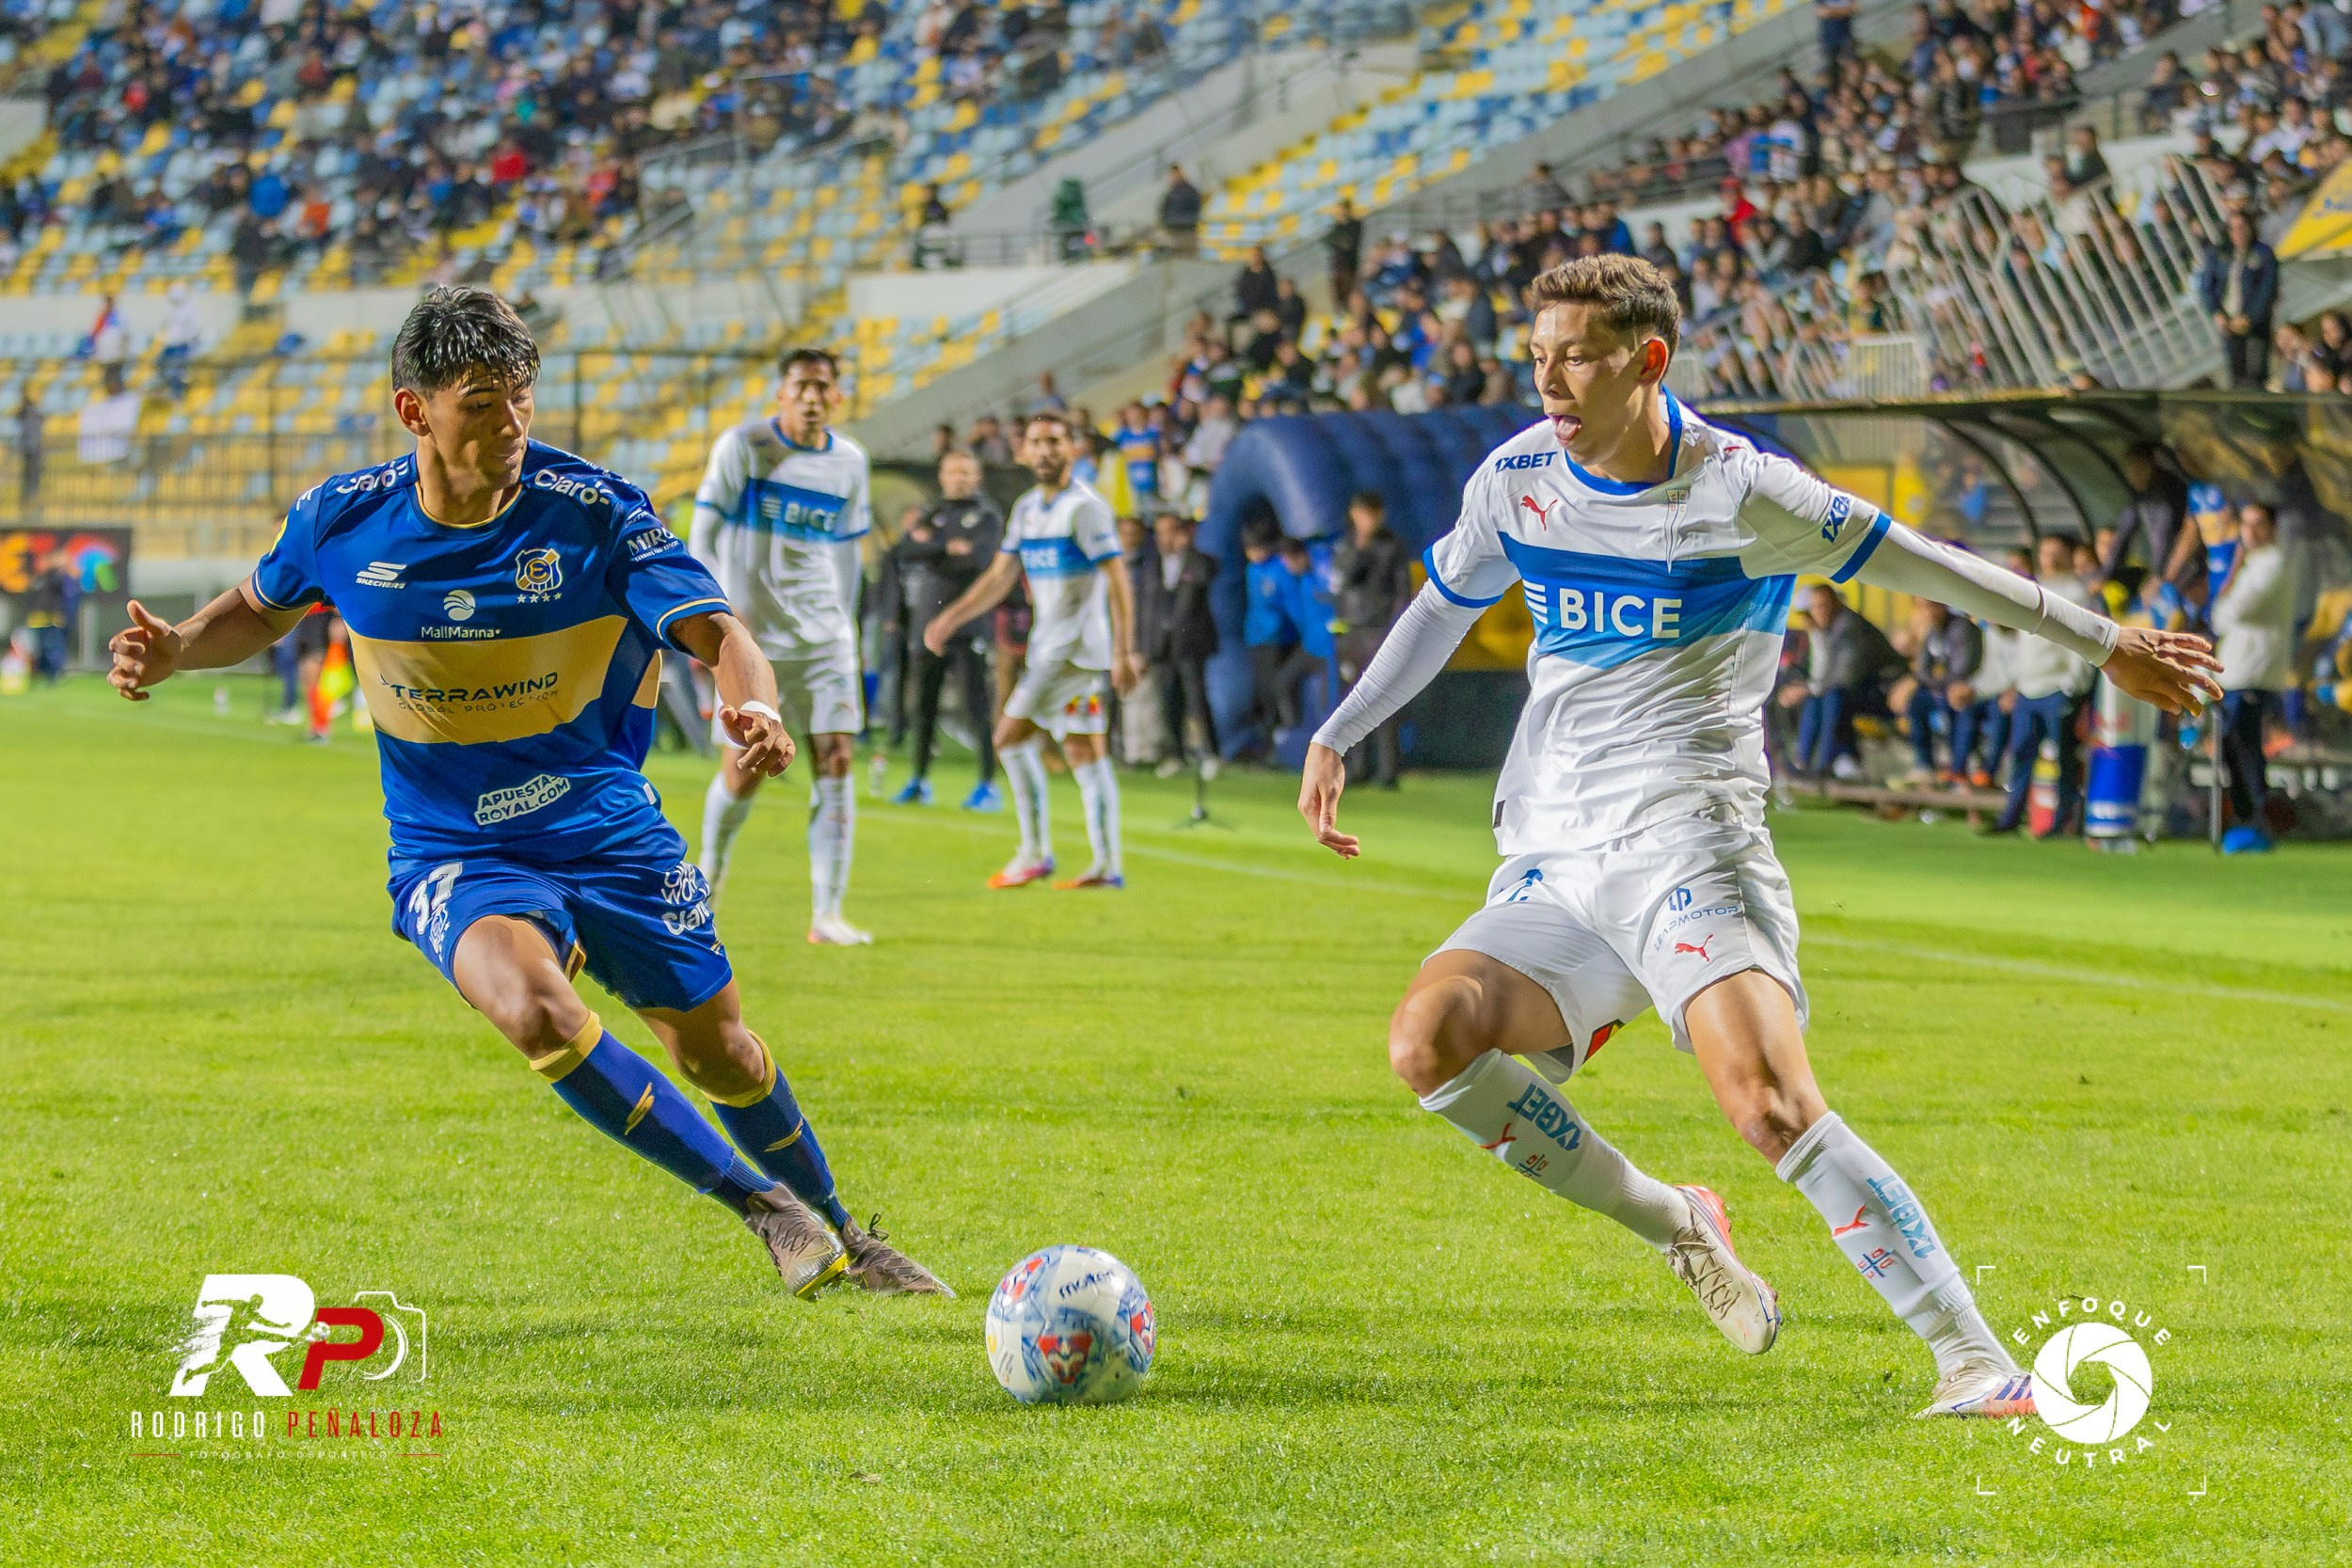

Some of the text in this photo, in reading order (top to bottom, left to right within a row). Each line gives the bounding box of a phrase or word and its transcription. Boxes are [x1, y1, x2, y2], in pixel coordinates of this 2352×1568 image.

[1495, 451, 1558, 473] 1XBET
[533, 468, 598, 505] Claro
[785, 502, 836, 533] BICE
[356, 578, 406, 590] SKECHERS
[1558, 588, 1682, 639] BICE
[421, 626, 496, 640] MallMarina
[390, 672, 558, 703] TERRAWIND
[478, 779, 569, 822] ROYAL.COM
[1654, 906, 1739, 951] LEAPMOTOR
[1506, 1082, 1581, 1151] 1XBET
[1866, 1174, 1935, 1259] 1XBET
